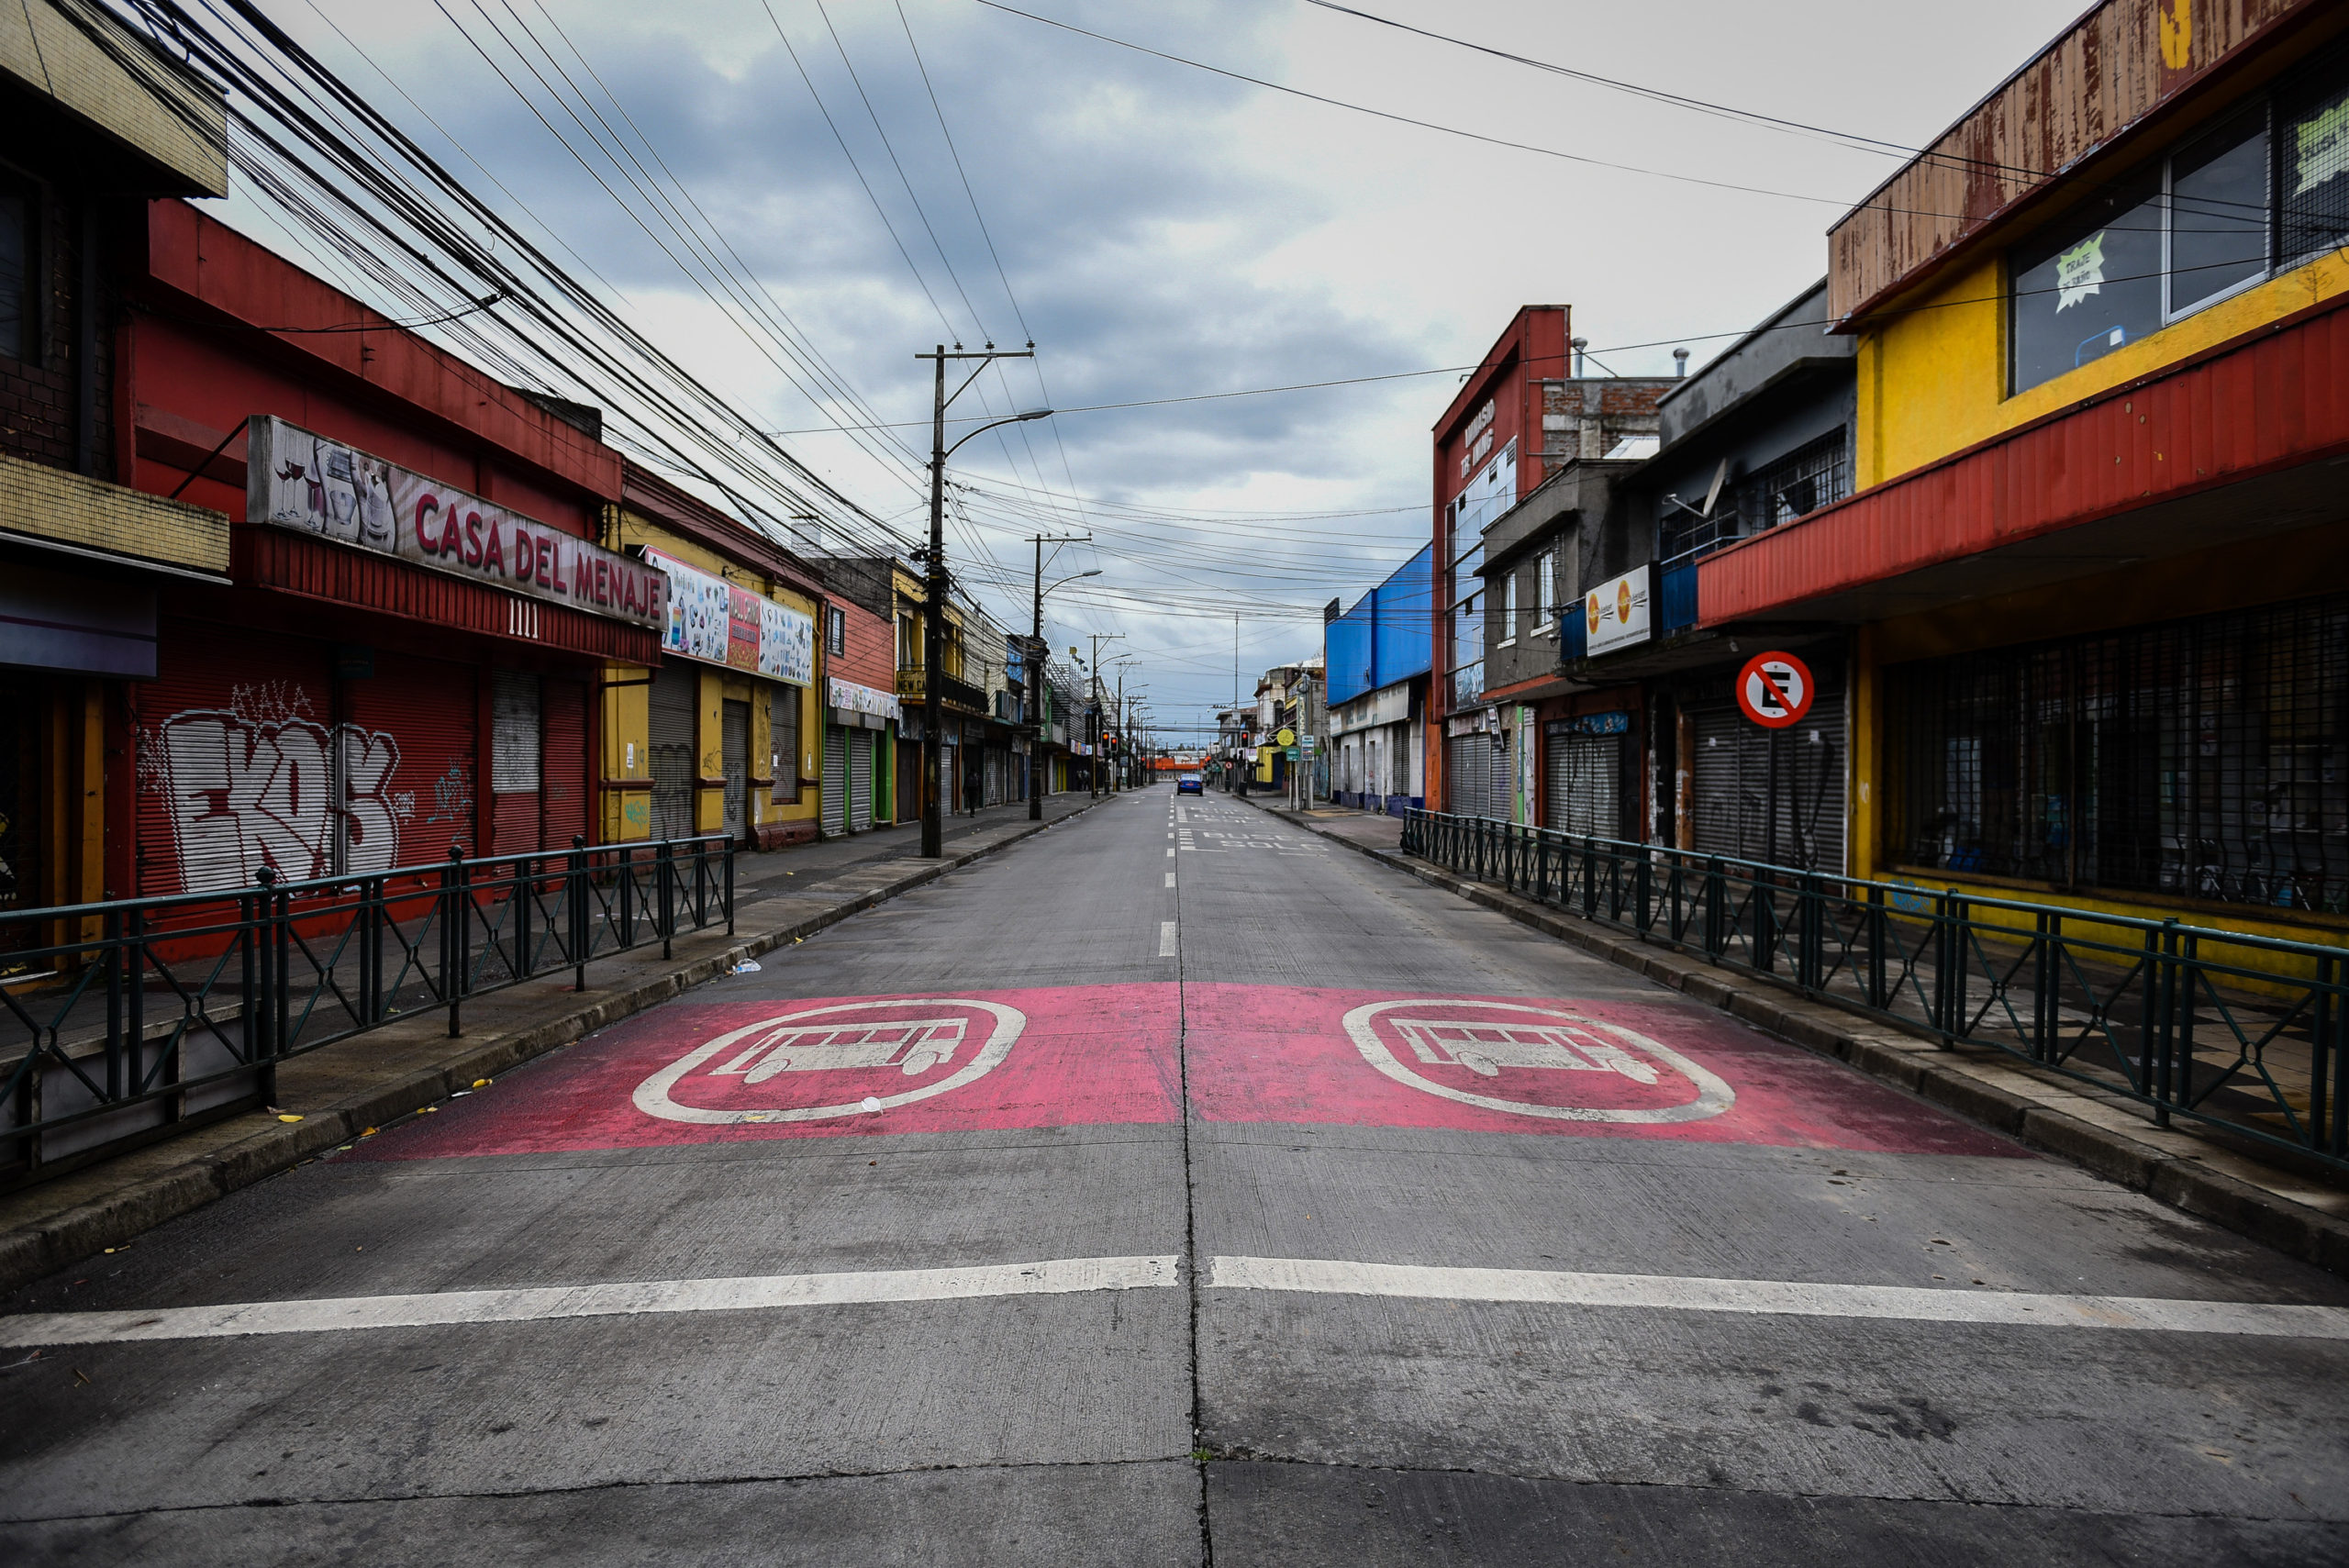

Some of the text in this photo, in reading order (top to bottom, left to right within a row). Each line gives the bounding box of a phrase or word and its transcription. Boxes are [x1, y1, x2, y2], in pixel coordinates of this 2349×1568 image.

[2065, 252, 2091, 274] TRAJE
[415, 493, 505, 575] CASA
[516, 528, 567, 592] DEL
[575, 553, 662, 619] MENAJE
[508, 598, 540, 639] 1111
[898, 681, 914, 692] NEW
[1763, 672, 1790, 707] E
[1220, 840, 1330, 851] SOLO
